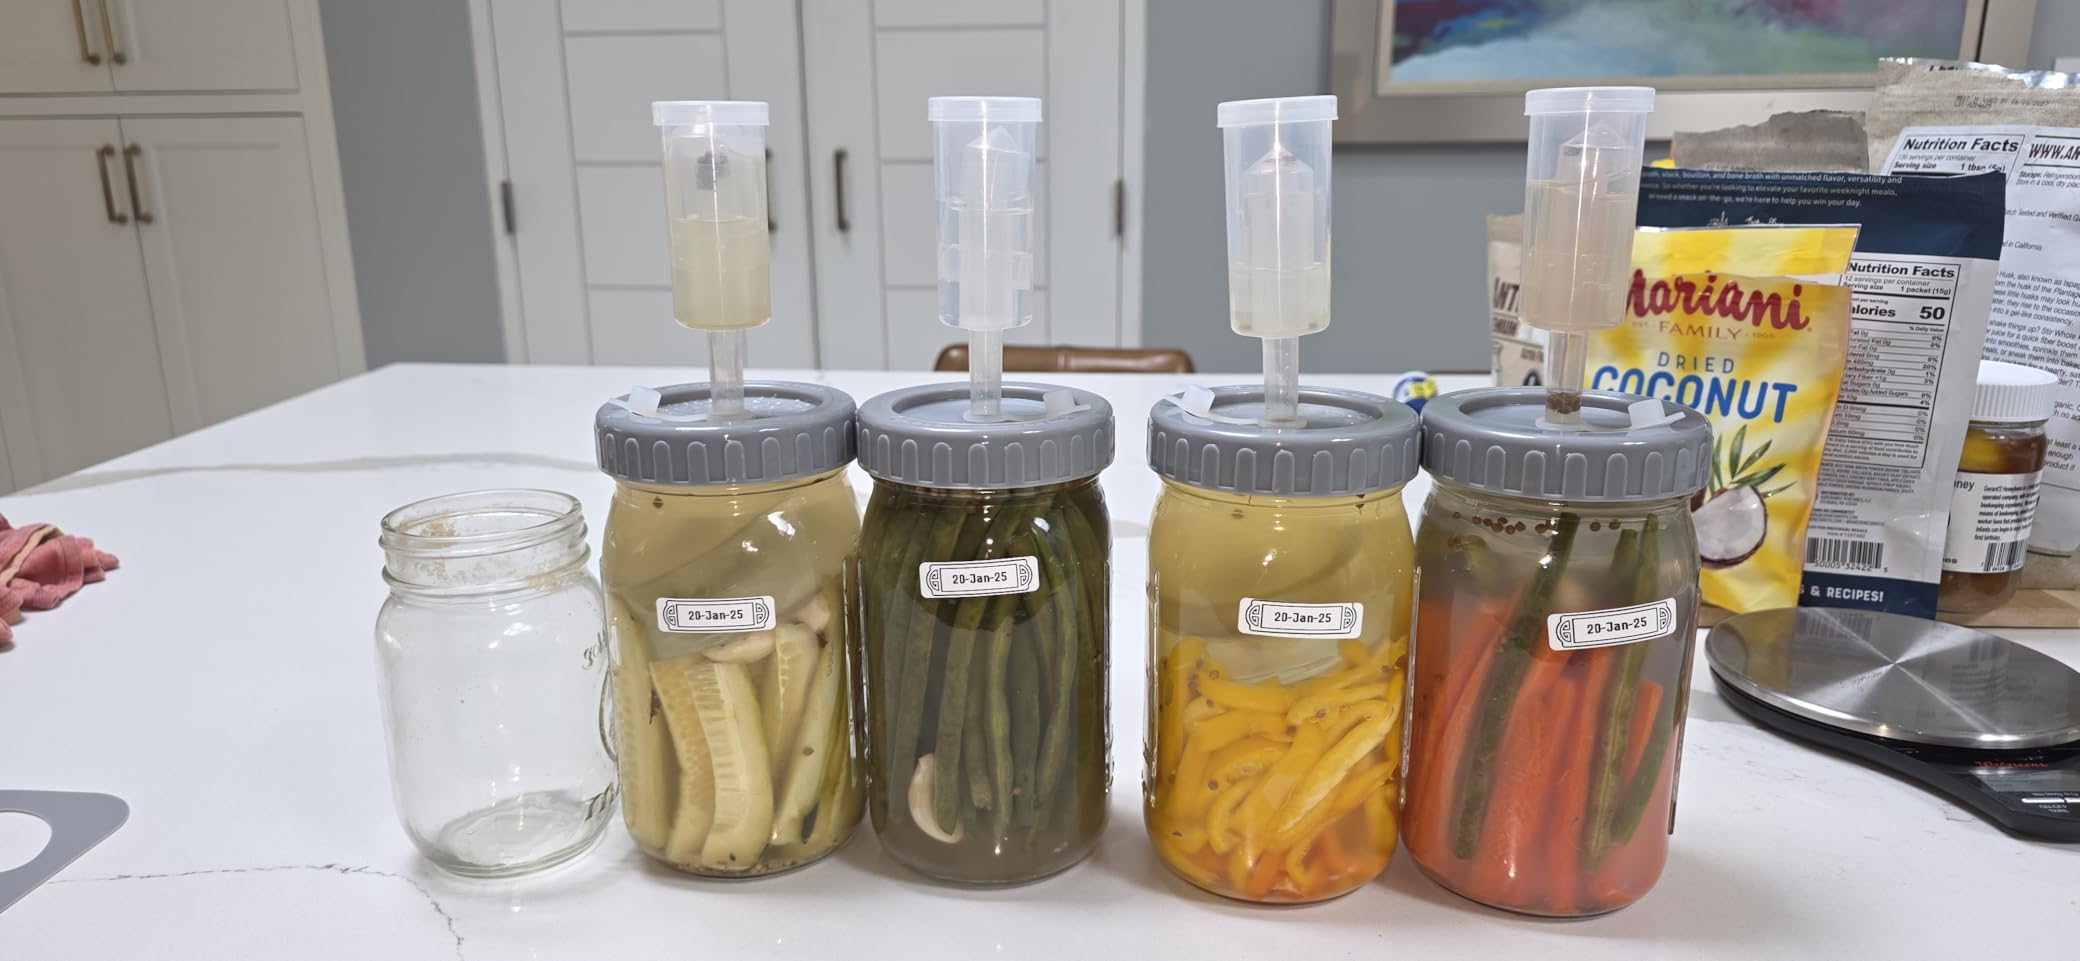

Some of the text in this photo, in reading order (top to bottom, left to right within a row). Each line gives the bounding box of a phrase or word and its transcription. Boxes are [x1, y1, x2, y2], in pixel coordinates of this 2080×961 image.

[1903, 138, 2019, 152] Nutrition Facts
[1894, 161, 1920, 170] Serving
[1727, 171, 1743, 179] bone
[1782, 174, 1820, 182] unmatched
[1848, 175, 1885, 185] versatility
[1721, 184, 1746, 192] looking
[1801, 186, 1828, 194] favorite
[1830, 187, 1870, 196] weeknight
[1781, 197, 1797, 205] help
[1846, 200, 1862, 208] day.
[2048, 211, 2072, 220] Verified
[2015, 241, 2042, 251] California
[1850, 262, 1955, 278] Nutrition Facts
[2000, 270, 2015, 280] Husk,
[2031, 275, 2052, 284] known
[2007, 299, 2019, 309] they
[2021, 291, 2039, 300] husks
[2041, 295, 2054, 304] may
[1920, 306, 1945, 320] 50
[2010, 310, 2032, 318] gel-like
[2034, 313, 2074, 327] consistency.
[1659, 320, 1742, 341] FAMILY
[2008, 322, 2026, 332] things
[2041, 327, 2053, 335] Stir
[2055, 330, 2076, 340] Whole
[1998, 340, 2030, 350] smoothies,
[2032, 345, 2058, 355] sprinkle
[2060, 349, 2078, 358] them
[2057, 340, 2077, 349] boost
[2008, 350, 2026, 359] sneak
[2028, 353, 2044, 361] them
[1658, 352, 1735, 374] DRIED
[1592, 365, 1798, 424] COCONUT
[2048, 450, 2073, 461] enough
[952, 571, 1008, 584] 20-Jan-25
[1810, 586, 1884, 602] & RECIPES!
[688, 608, 744, 621] 20-Jan-25
[1274, 611, 1332, 625] 20-Jan-25
[1586, 616, 1648, 636] 20-Jan-25
